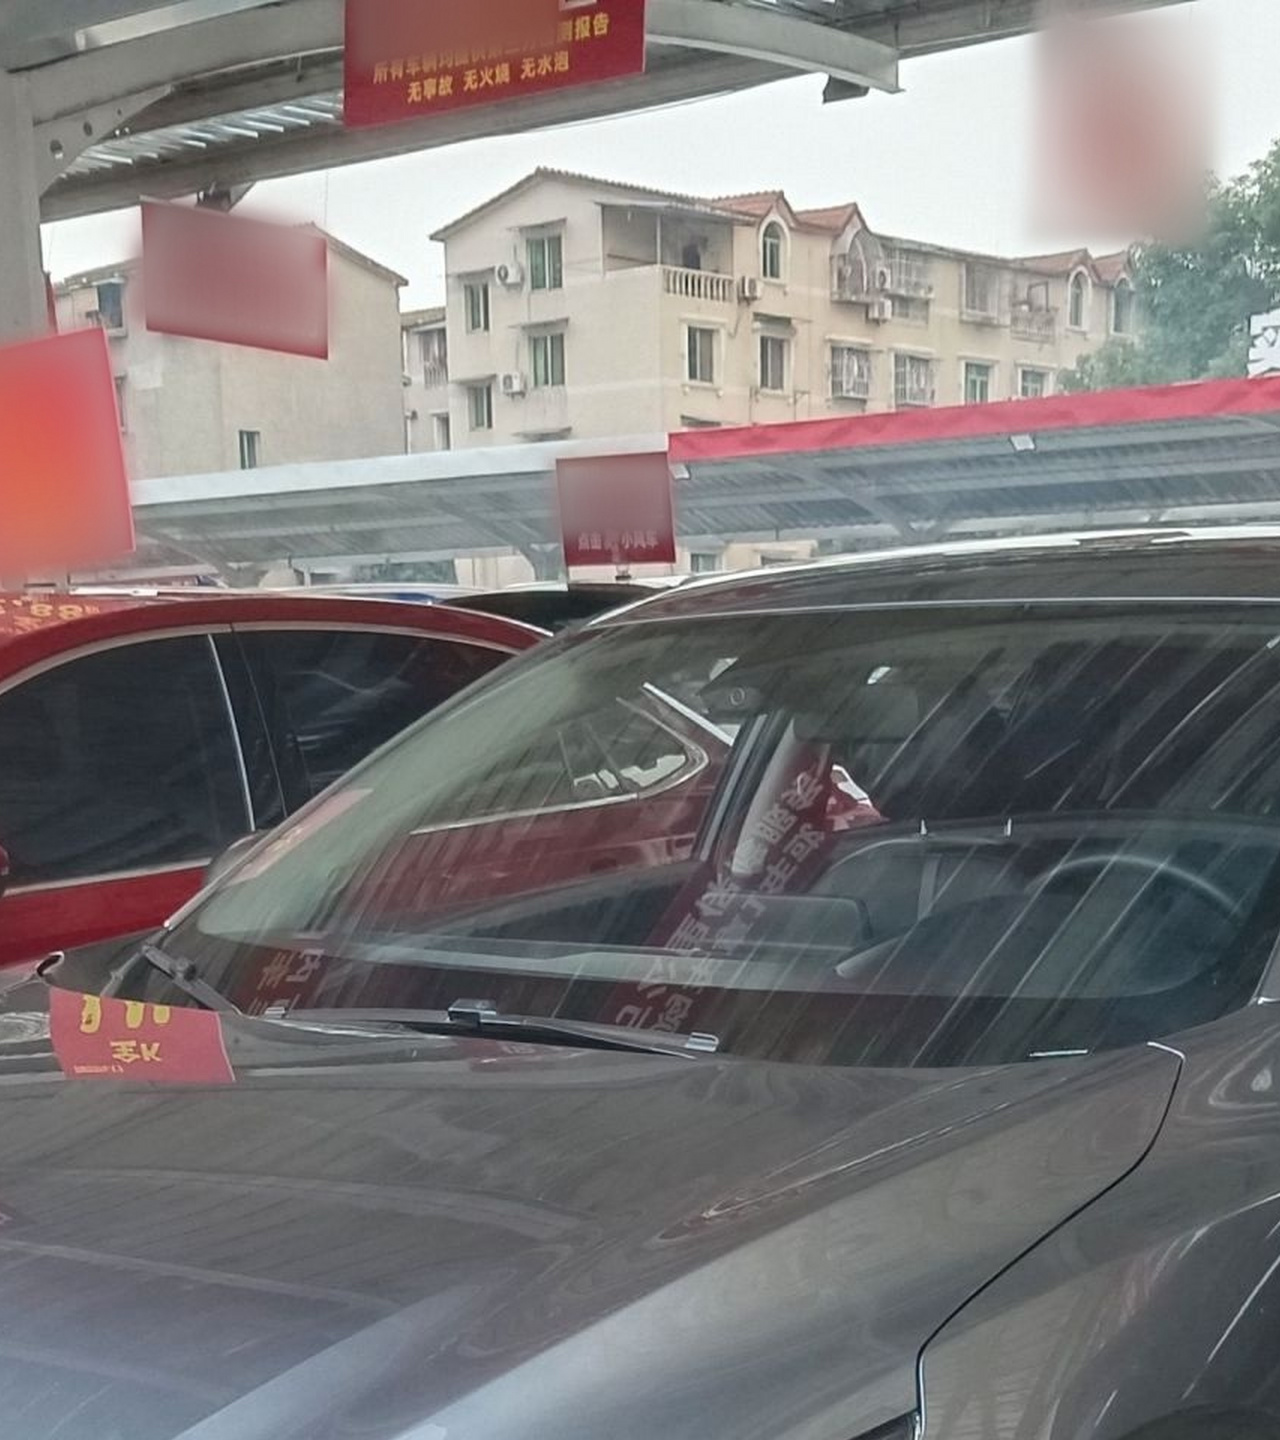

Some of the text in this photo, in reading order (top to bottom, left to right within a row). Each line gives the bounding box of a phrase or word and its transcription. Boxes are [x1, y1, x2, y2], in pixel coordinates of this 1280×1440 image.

[407, 51, 570, 104] 无事故 无火烧 无水泡
